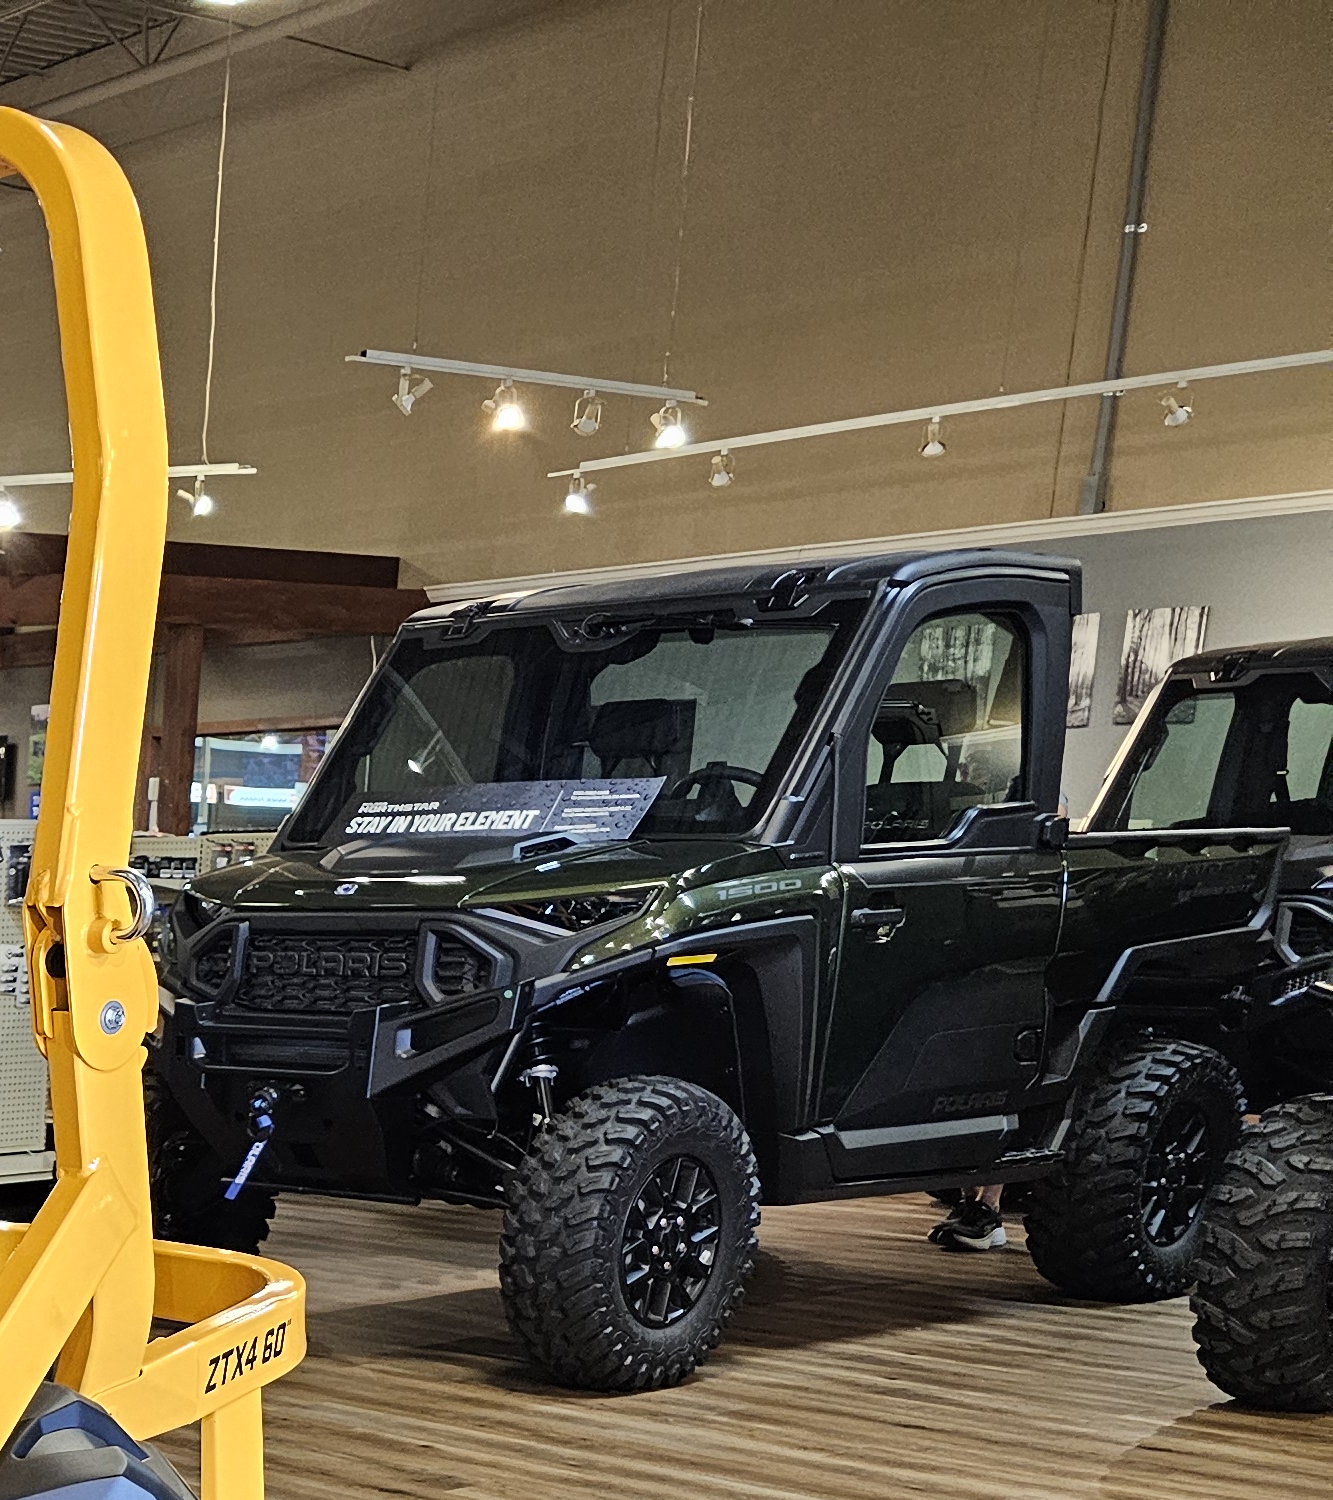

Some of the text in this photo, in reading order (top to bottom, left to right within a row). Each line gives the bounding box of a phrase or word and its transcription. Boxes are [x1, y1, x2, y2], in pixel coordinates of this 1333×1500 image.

[345, 809, 541, 834] STAY IN YOUR ELEMENT
[716, 878, 803, 901] 1500
[250, 951, 408, 977] POLARIS
[205, 1334, 259, 1394] ZTX4
